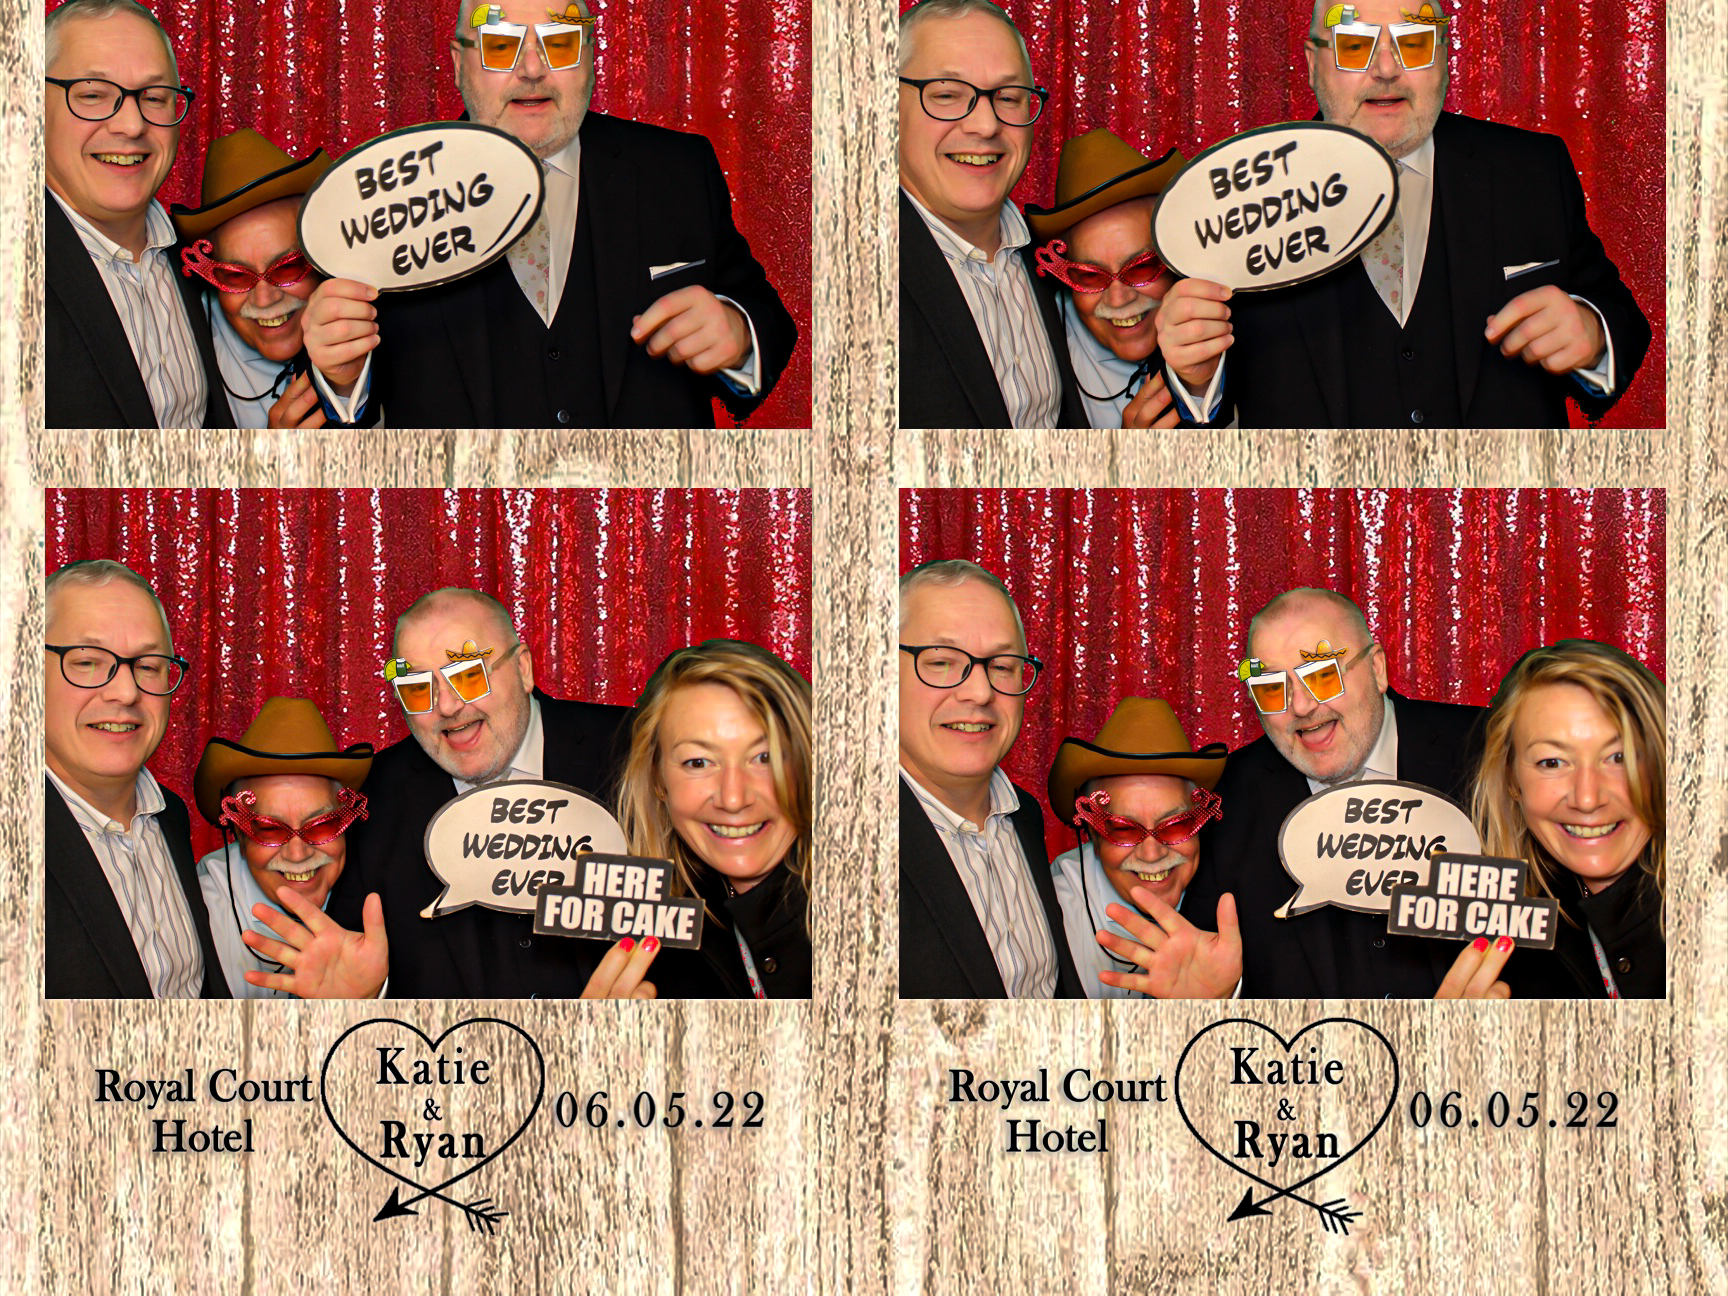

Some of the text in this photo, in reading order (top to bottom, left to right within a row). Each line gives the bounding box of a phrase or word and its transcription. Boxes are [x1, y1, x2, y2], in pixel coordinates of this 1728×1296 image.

[355, 140, 443, 200] BEST
[1209, 140, 1297, 200] BEST
[340, 173, 494, 249] WEDDING
[1194, 173, 1348, 249] WEDDING
[392, 226, 476, 275] EVER
[1246, 226, 1330, 275] EVER
[490, 797, 569, 824] BEST
[1344, 797, 1423, 824] BEST
[582, 862, 665, 901] HERE
[1436, 862, 1519, 901] HERE
[543, 894, 696, 940] FOR CAKE
[1397, 894, 1550, 940] FOR CAKE
